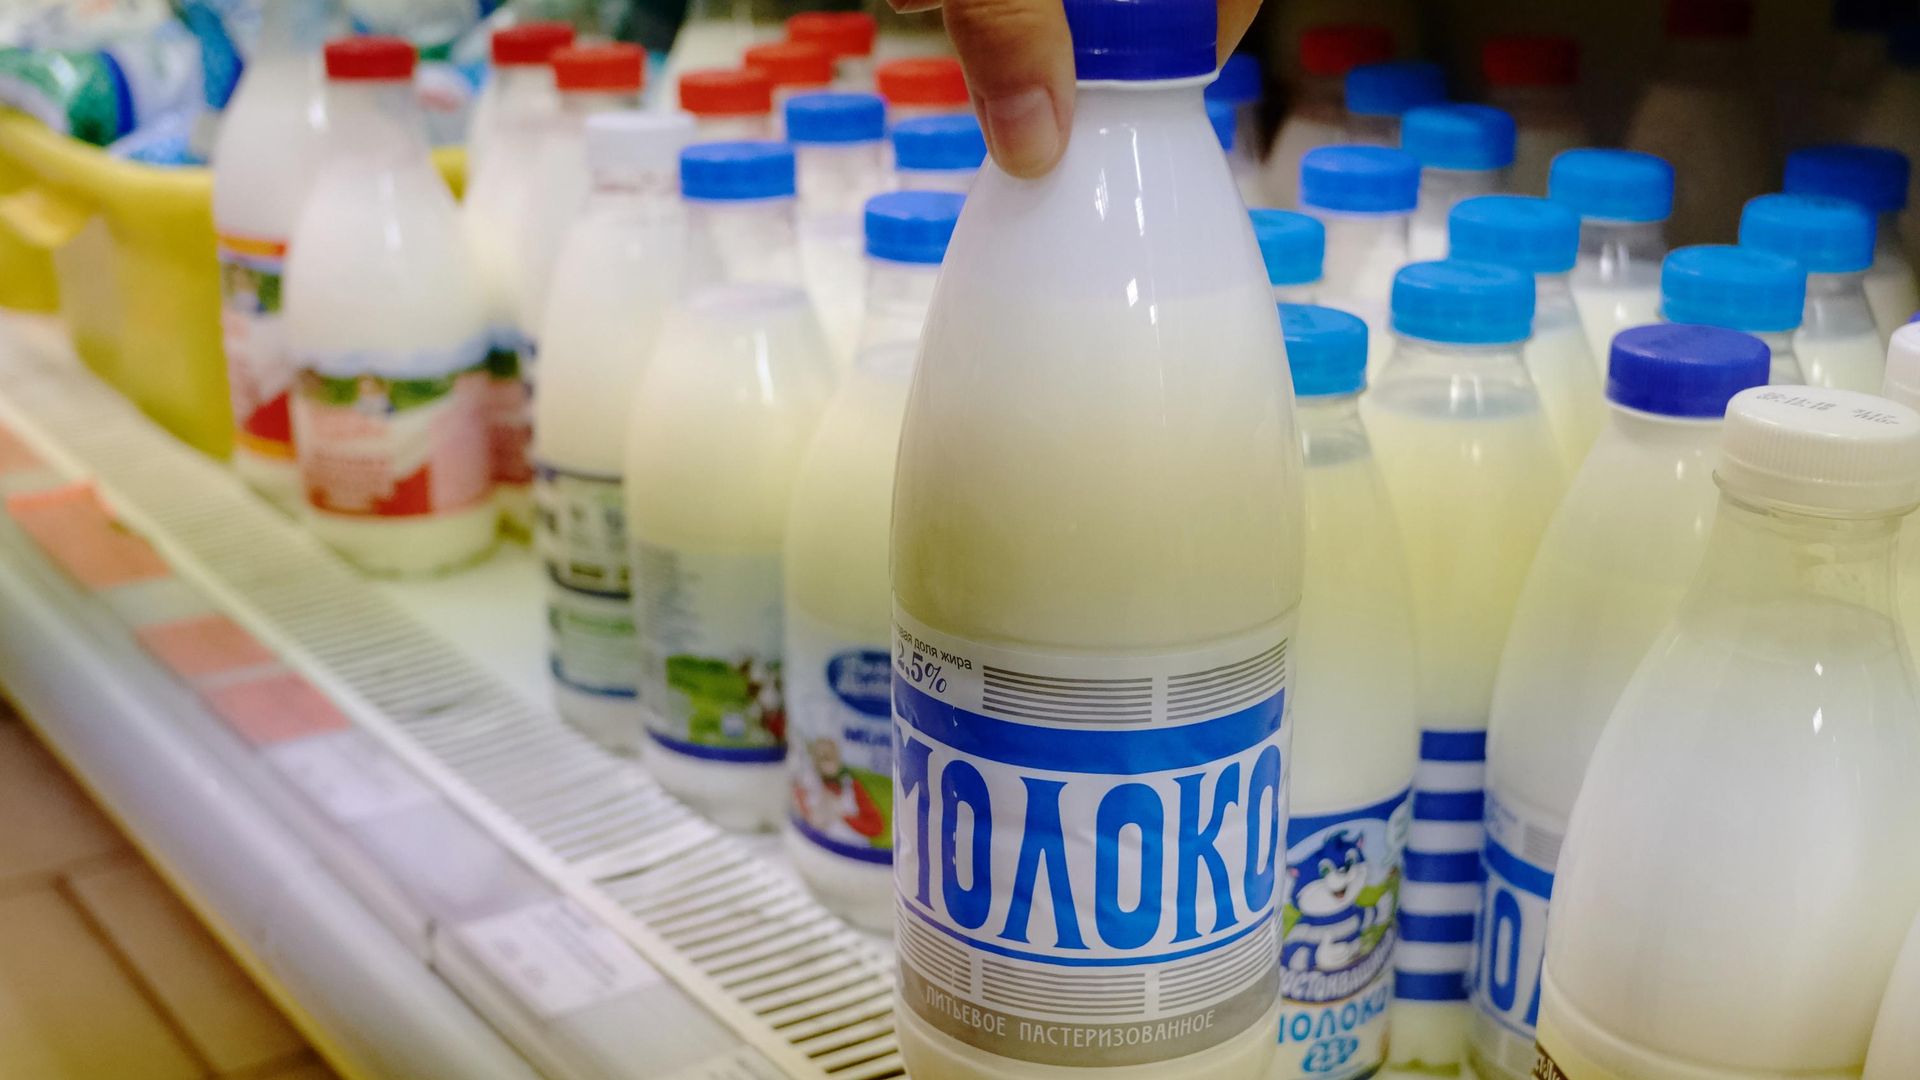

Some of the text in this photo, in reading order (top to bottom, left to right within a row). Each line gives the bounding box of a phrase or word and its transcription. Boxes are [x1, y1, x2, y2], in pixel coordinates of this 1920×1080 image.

[897, 640, 947, 693] 2,5%
[914, 638, 938, 658] доля
[940, 650, 973, 670] жира
[925, 984, 1215, 1047] ПИТЬЕВОЕ ПАСТЕРИЗОВАННОЕ
